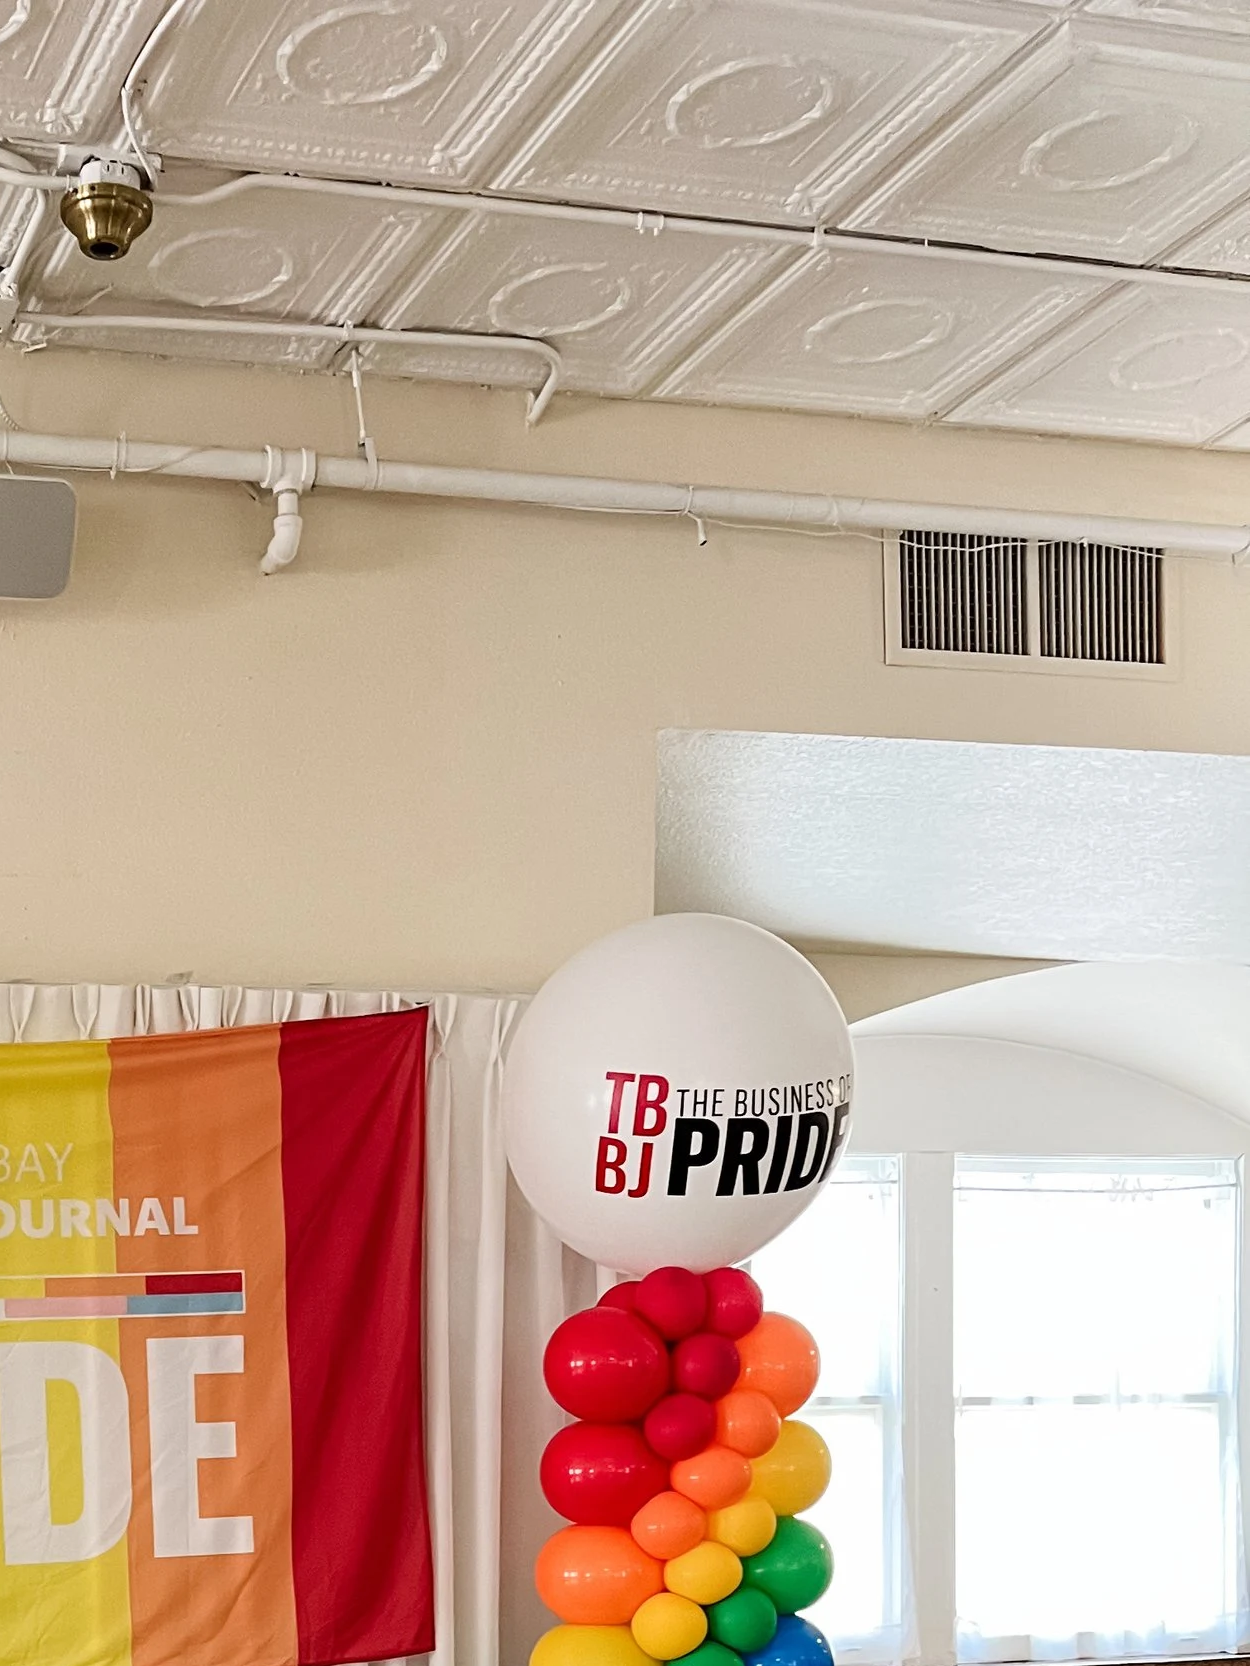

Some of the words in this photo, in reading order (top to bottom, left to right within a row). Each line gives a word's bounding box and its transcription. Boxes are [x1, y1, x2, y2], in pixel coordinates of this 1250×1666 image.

[606, 1071, 669, 1137] TB
[677, 1089, 725, 1117] THE
[735, 1078, 833, 1117] BUSINESS
[595, 1135, 654, 1198] BJ
